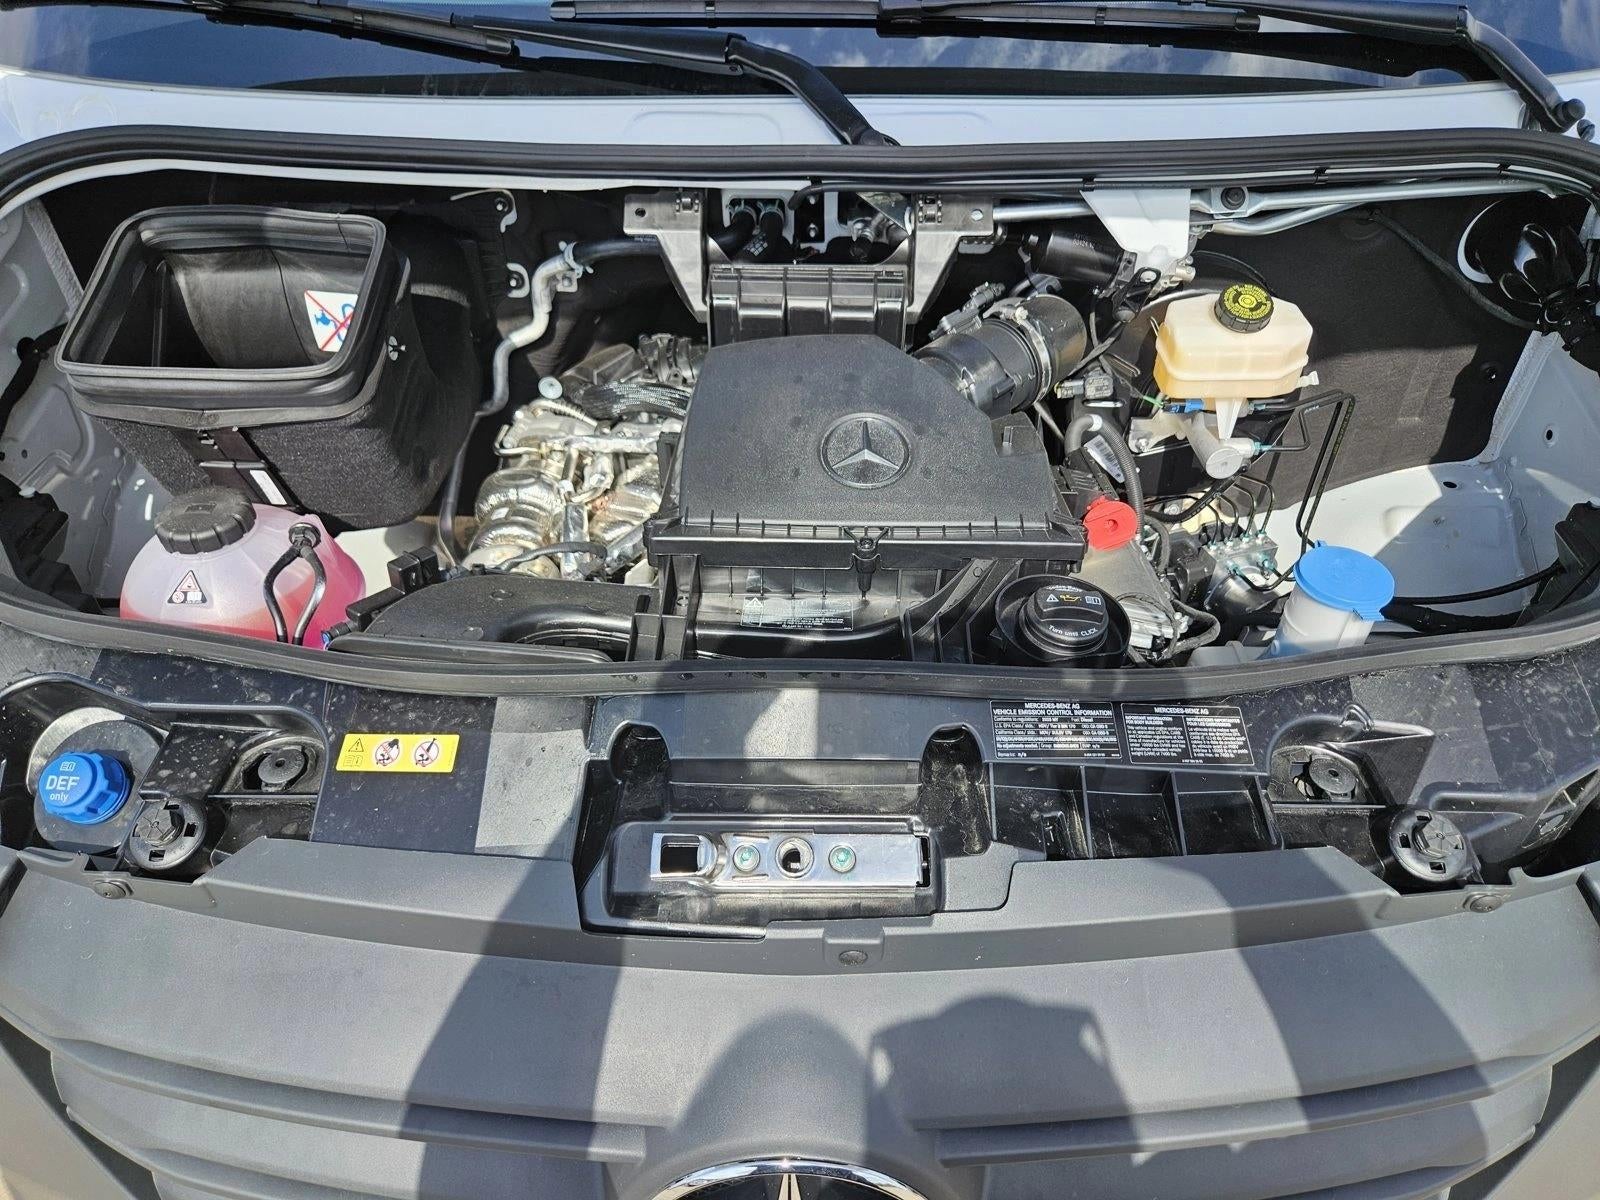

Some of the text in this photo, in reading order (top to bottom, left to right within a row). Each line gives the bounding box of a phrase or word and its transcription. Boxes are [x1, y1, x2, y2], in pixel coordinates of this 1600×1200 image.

[1048, 624, 1063, 635] Turn
[1080, 627, 1098, 637] CLICK
[45, 775, 80, 791] DEF
[49, 792, 69, 803] only
